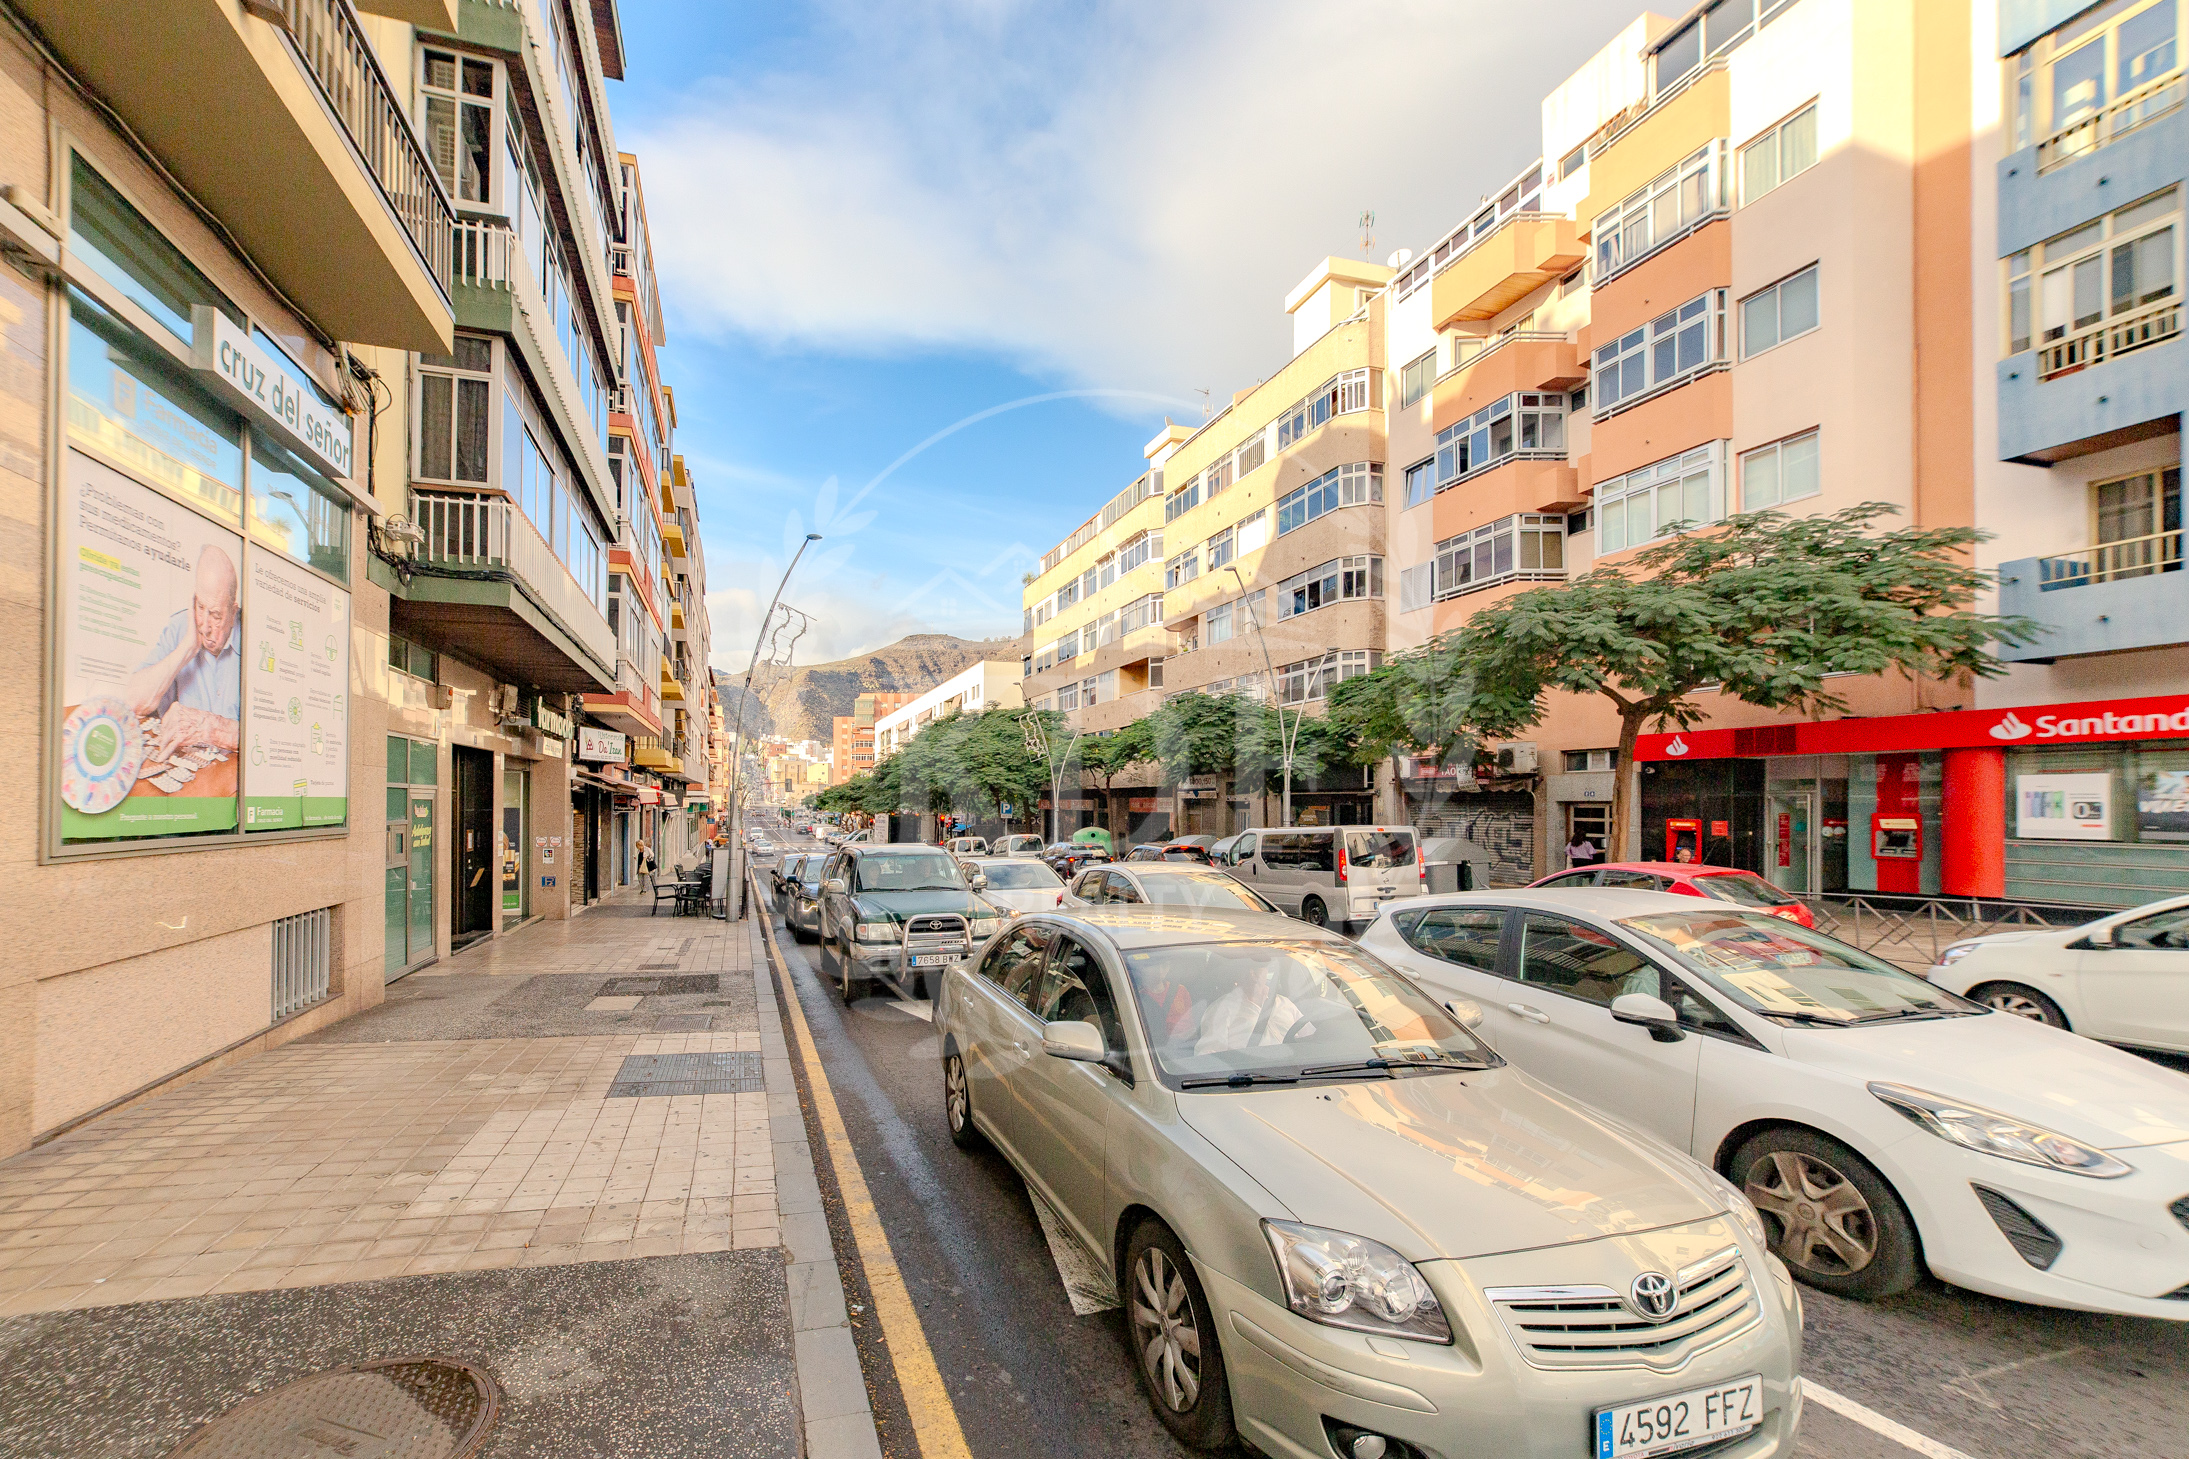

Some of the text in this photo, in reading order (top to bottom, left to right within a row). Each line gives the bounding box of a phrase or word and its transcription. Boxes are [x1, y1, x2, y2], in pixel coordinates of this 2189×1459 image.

[220, 339, 349, 469] cruz del señor
[143, 389, 218, 456] Farmacia
[79, 500, 181, 552] sus medicamentos?
[146, 515, 165, 531] con
[143, 545, 191, 571] ayudarle
[255, 563, 327, 604] Le ofrecemos una amplia
[255, 578, 320, 613] variedad de servicios
[257, 807, 283, 816] Farmacia
[1003, 804, 1010, 815] P
[917, 956, 940, 964] 7658
[1602, 1384, 1754, 1451] E 4592 FFZ
